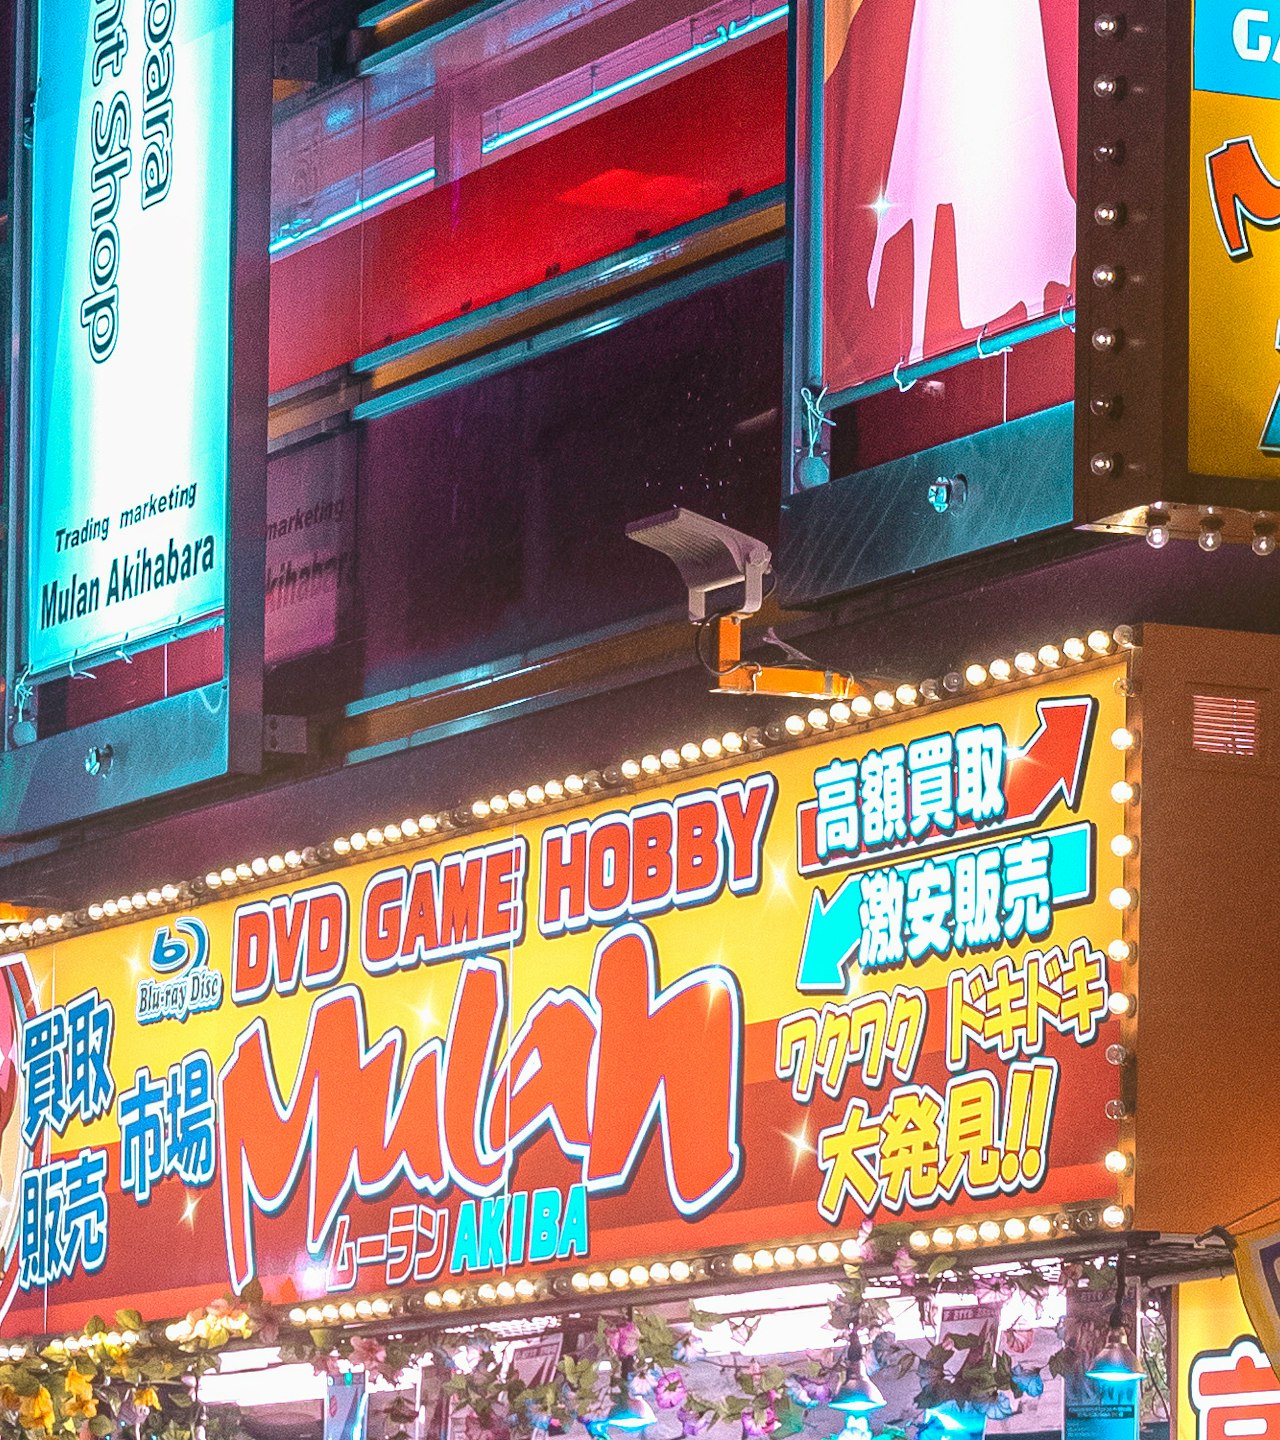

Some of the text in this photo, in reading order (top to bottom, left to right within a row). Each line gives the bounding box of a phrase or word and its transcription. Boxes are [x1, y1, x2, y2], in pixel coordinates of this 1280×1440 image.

[81, 93, 133, 363] Shop
[40, 572, 100, 630] Mulan
[106, 529, 216, 608] Akihabara
[55, 480, 198, 553] Trading marketing
[816, 722, 1007, 859] 高額買取
[232, 774, 774, 1004] DVD GAME HOBBY
[857, 837, 1053, 972] 激安販売
[137, 967, 222, 1020] Blu-ray Disc
[777, 938, 1110, 1099] ワクワク ドキドキ
[22, 990, 115, 1145] 買取
[120, 1051, 215, 1201] 市場
[220, 919, 742, 1295] Mulan
[817, 1059, 1059, 1221] 大発見!!
[20, 1149, 107, 1287] 販売
[326, 1201, 450, 1292] ムーラン
[450, 1184, 588, 1275] AKIBA
